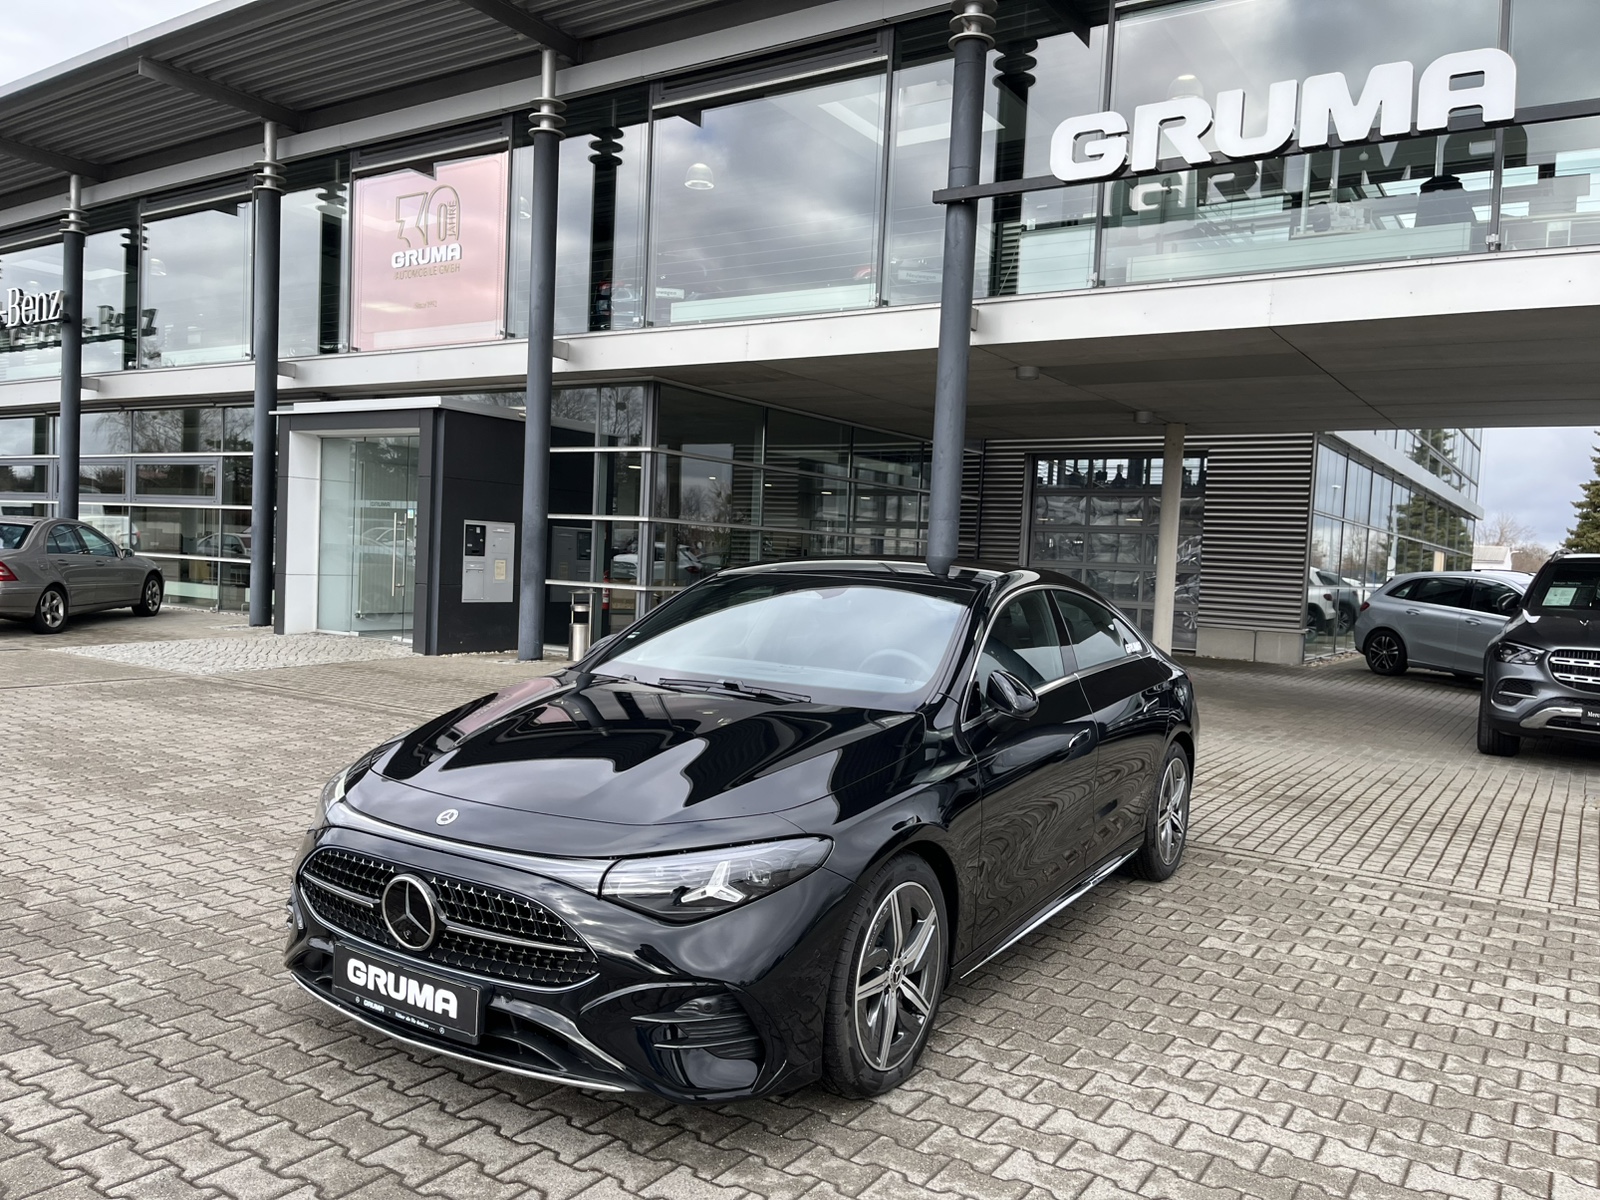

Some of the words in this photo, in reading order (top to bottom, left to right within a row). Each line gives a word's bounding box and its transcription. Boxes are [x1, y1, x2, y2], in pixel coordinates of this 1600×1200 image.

[1049, 48, 1517, 182] GRUMA
[448, 200, 457, 237] JAHRE
[391, 243, 461, 268] GRUMA
[347, 958, 457, 1019] GRUMA
[363, 1000, 385, 1013] GRUMA
